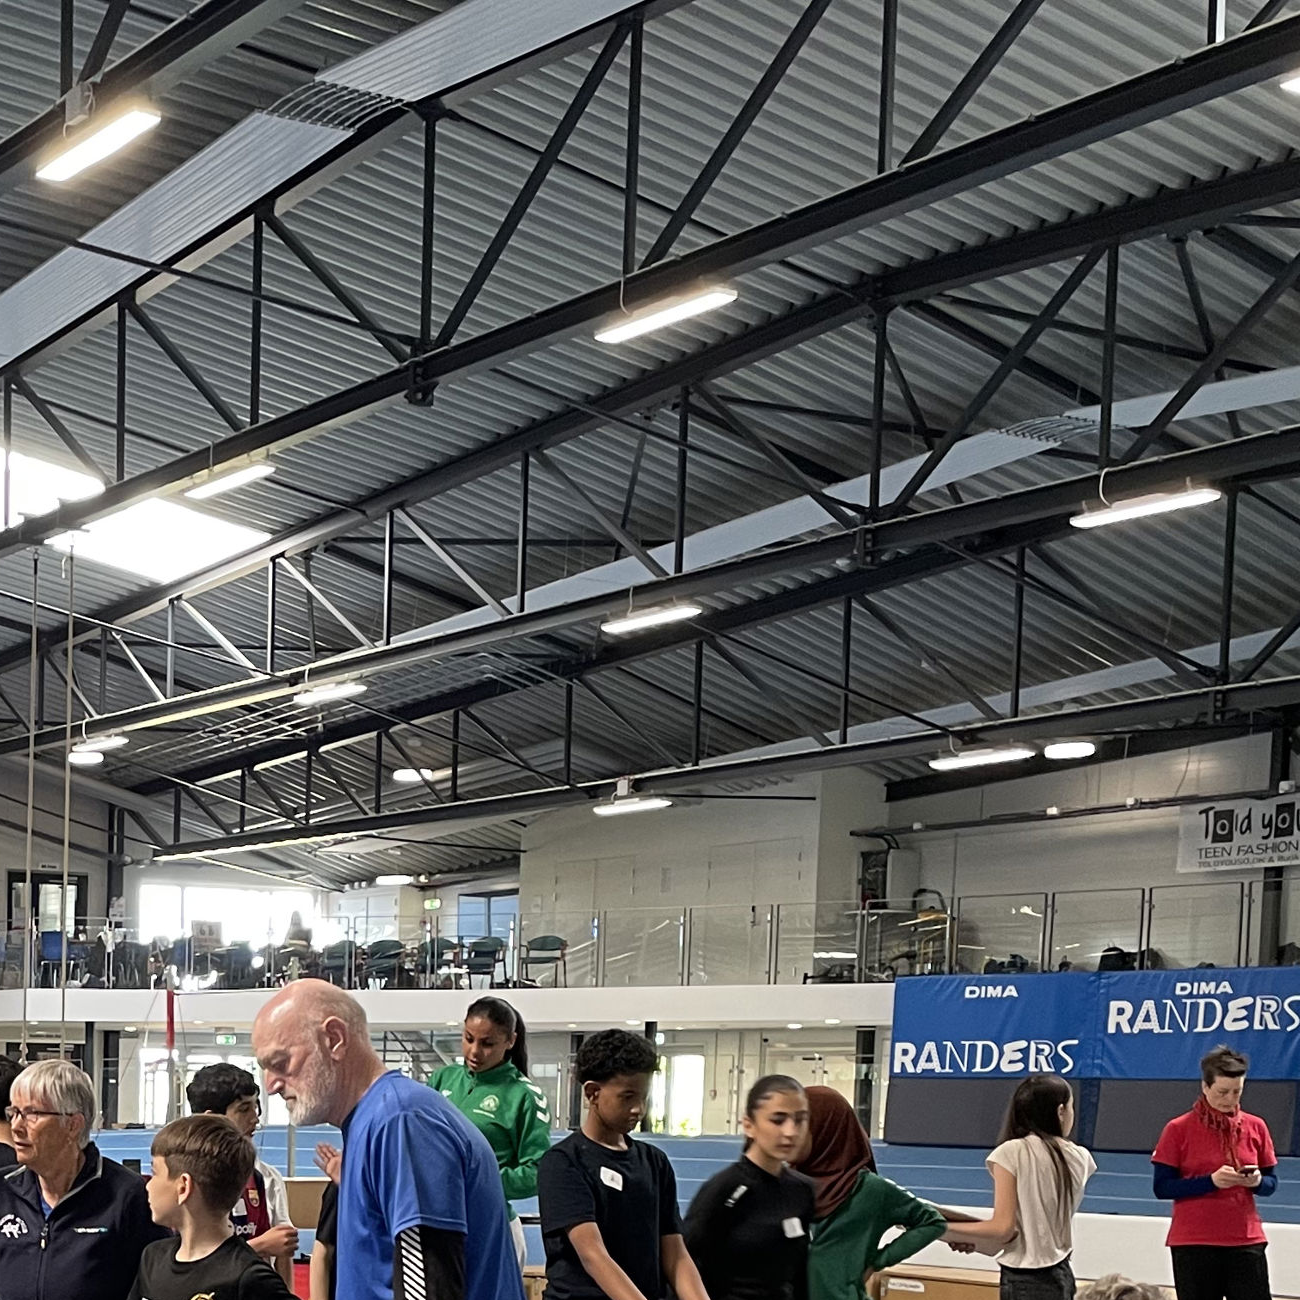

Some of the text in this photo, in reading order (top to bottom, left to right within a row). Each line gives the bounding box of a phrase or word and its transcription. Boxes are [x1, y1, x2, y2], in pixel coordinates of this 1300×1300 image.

[1198, 803, 1300, 843] Told yo
[1197, 840, 1299, 859] TEEN FASHION
[964, 984, 1018, 999] DIMA
[1175, 981, 1233, 996] DIMA
[1107, 995, 1300, 1033] RANDERS
[894, 1039, 1079, 1073] RANDERS
